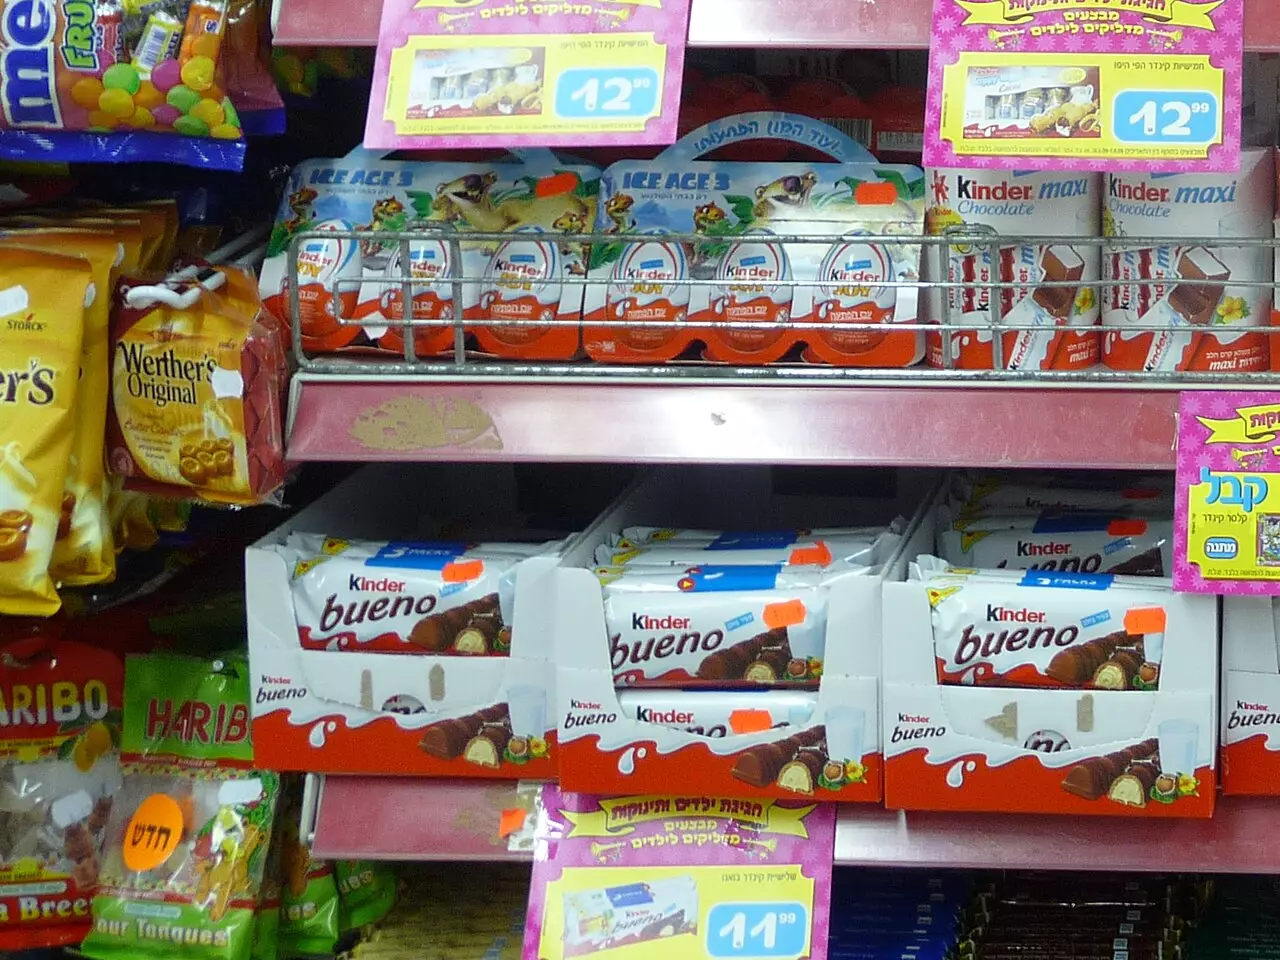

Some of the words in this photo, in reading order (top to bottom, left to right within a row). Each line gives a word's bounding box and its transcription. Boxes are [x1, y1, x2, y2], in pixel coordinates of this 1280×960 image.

[309, 169, 349, 185] ICE
[350, 169, 395, 186] AGE
[623, 171, 663, 189] ICE
[665, 172, 711, 190] AGE
[712, 172, 731, 191] 3
[957, 175, 1033, 201] Kinder
[1038, 178, 1088, 199] maxi
[1109, 174, 1170, 202] Kinder
[1175, 181, 1237, 204] maxi
[958, 201, 1034, 216] Chocolate
[1109, 200, 1170, 218] Chocolate
[494, 261, 542, 277] Kinder
[726, 265, 774, 278] Kinder
[830, 268, 880, 282] Kinder
[7, 318, 46, 331] STORCK
[1209, 358, 1237, 370] maxi
[128, 372, 196, 407] Original
[1200, 466, 1268, 512] קבל
[349, 573, 405, 593] Kinder
[319, 593, 437, 633] bueno
[632, 612, 691, 630] Kinder
[986, 604, 1045, 623] Kinder
[610, 628, 724, 670] bueno
[954, 624, 1079, 665] bueno
[261, 675, 291, 685] Kinder
[256, 687, 307, 704] bueno
[899, 713, 930, 723] Kinder
[891, 725, 946, 743] bueno
[130, 824, 172, 852] חדש
